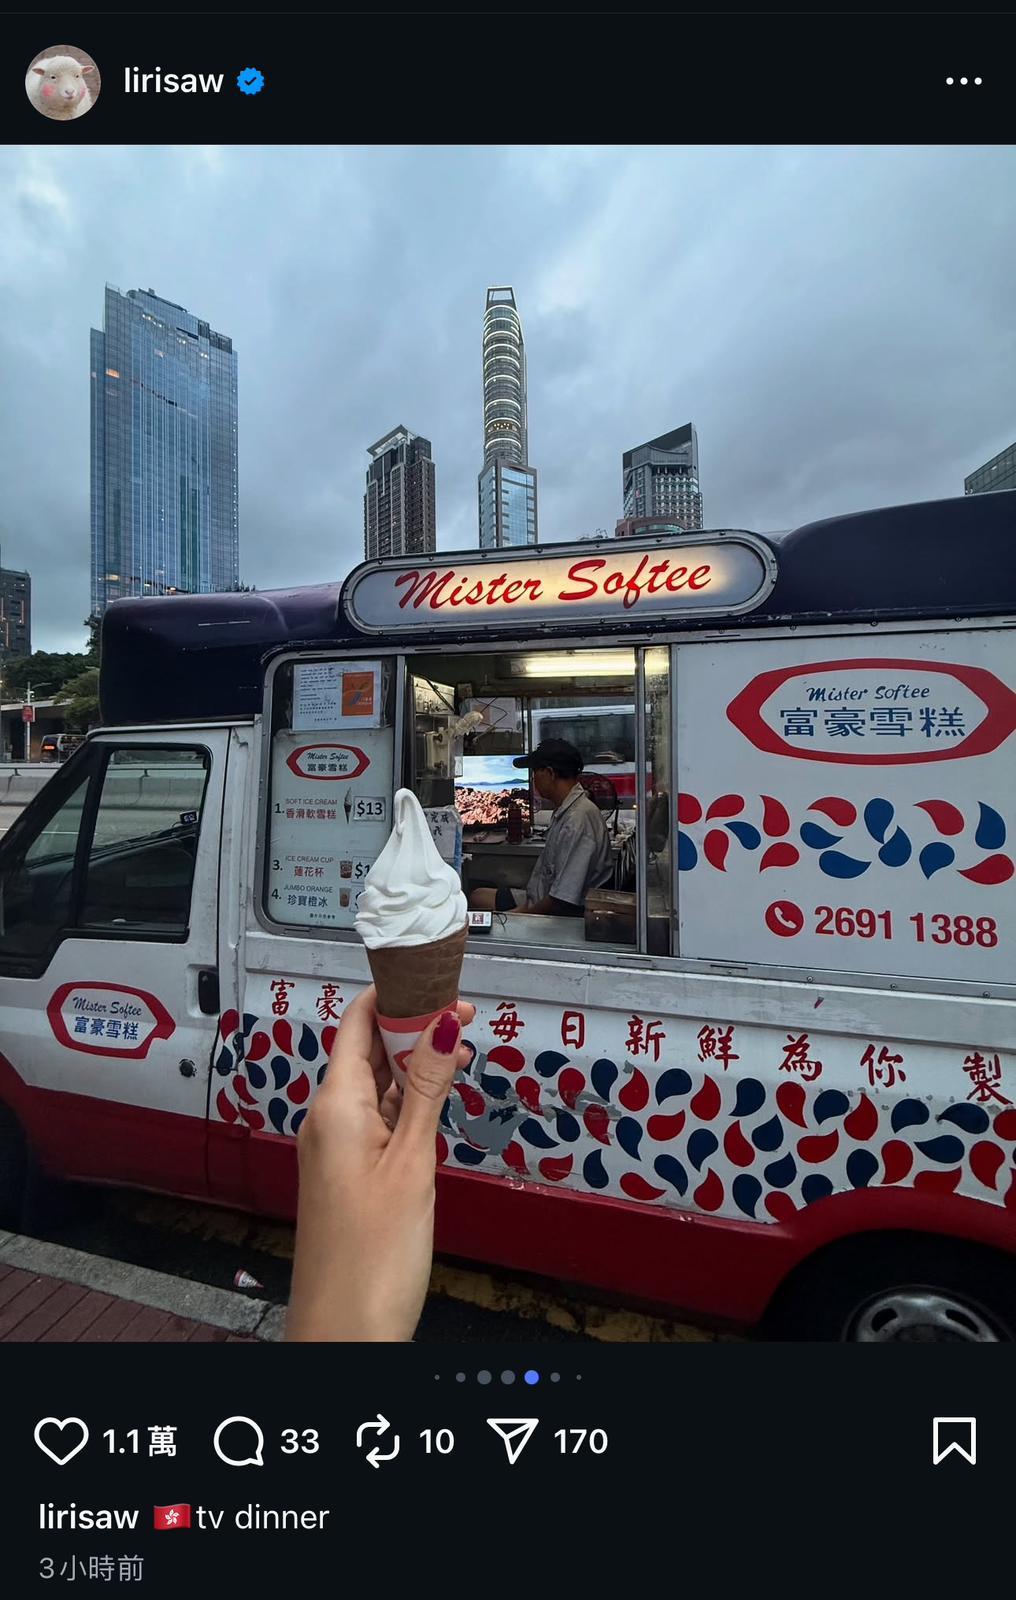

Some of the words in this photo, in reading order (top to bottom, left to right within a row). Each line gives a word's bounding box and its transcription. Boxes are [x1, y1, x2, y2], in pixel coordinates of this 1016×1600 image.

[395, 571, 543, 609] Mister
[558, 554, 711, 609] Softee
[806, 686, 868, 701] Mister
[874, 684, 931, 700] Softee
[779, 706, 966, 738] 富豪雪糕
[307, 752, 328, 760] Mister
[307, 763, 348, 772] 富豪雪糕
[274, 803, 285, 814] 1.
[357, 800, 383, 817] $13
[272, 860, 283, 871] 3.
[354, 862, 370, 879] $1
[271, 889, 282, 900] 4.
[288, 895, 328, 908] 珍寶橙冰
[814, 906, 893, 940] 2691
[909, 912, 999, 948] 1388
[73, 997, 107, 1013] Mister
[110, 1001, 142, 1018] Softee
[74, 1016, 139, 1041] 富豪雪糕
